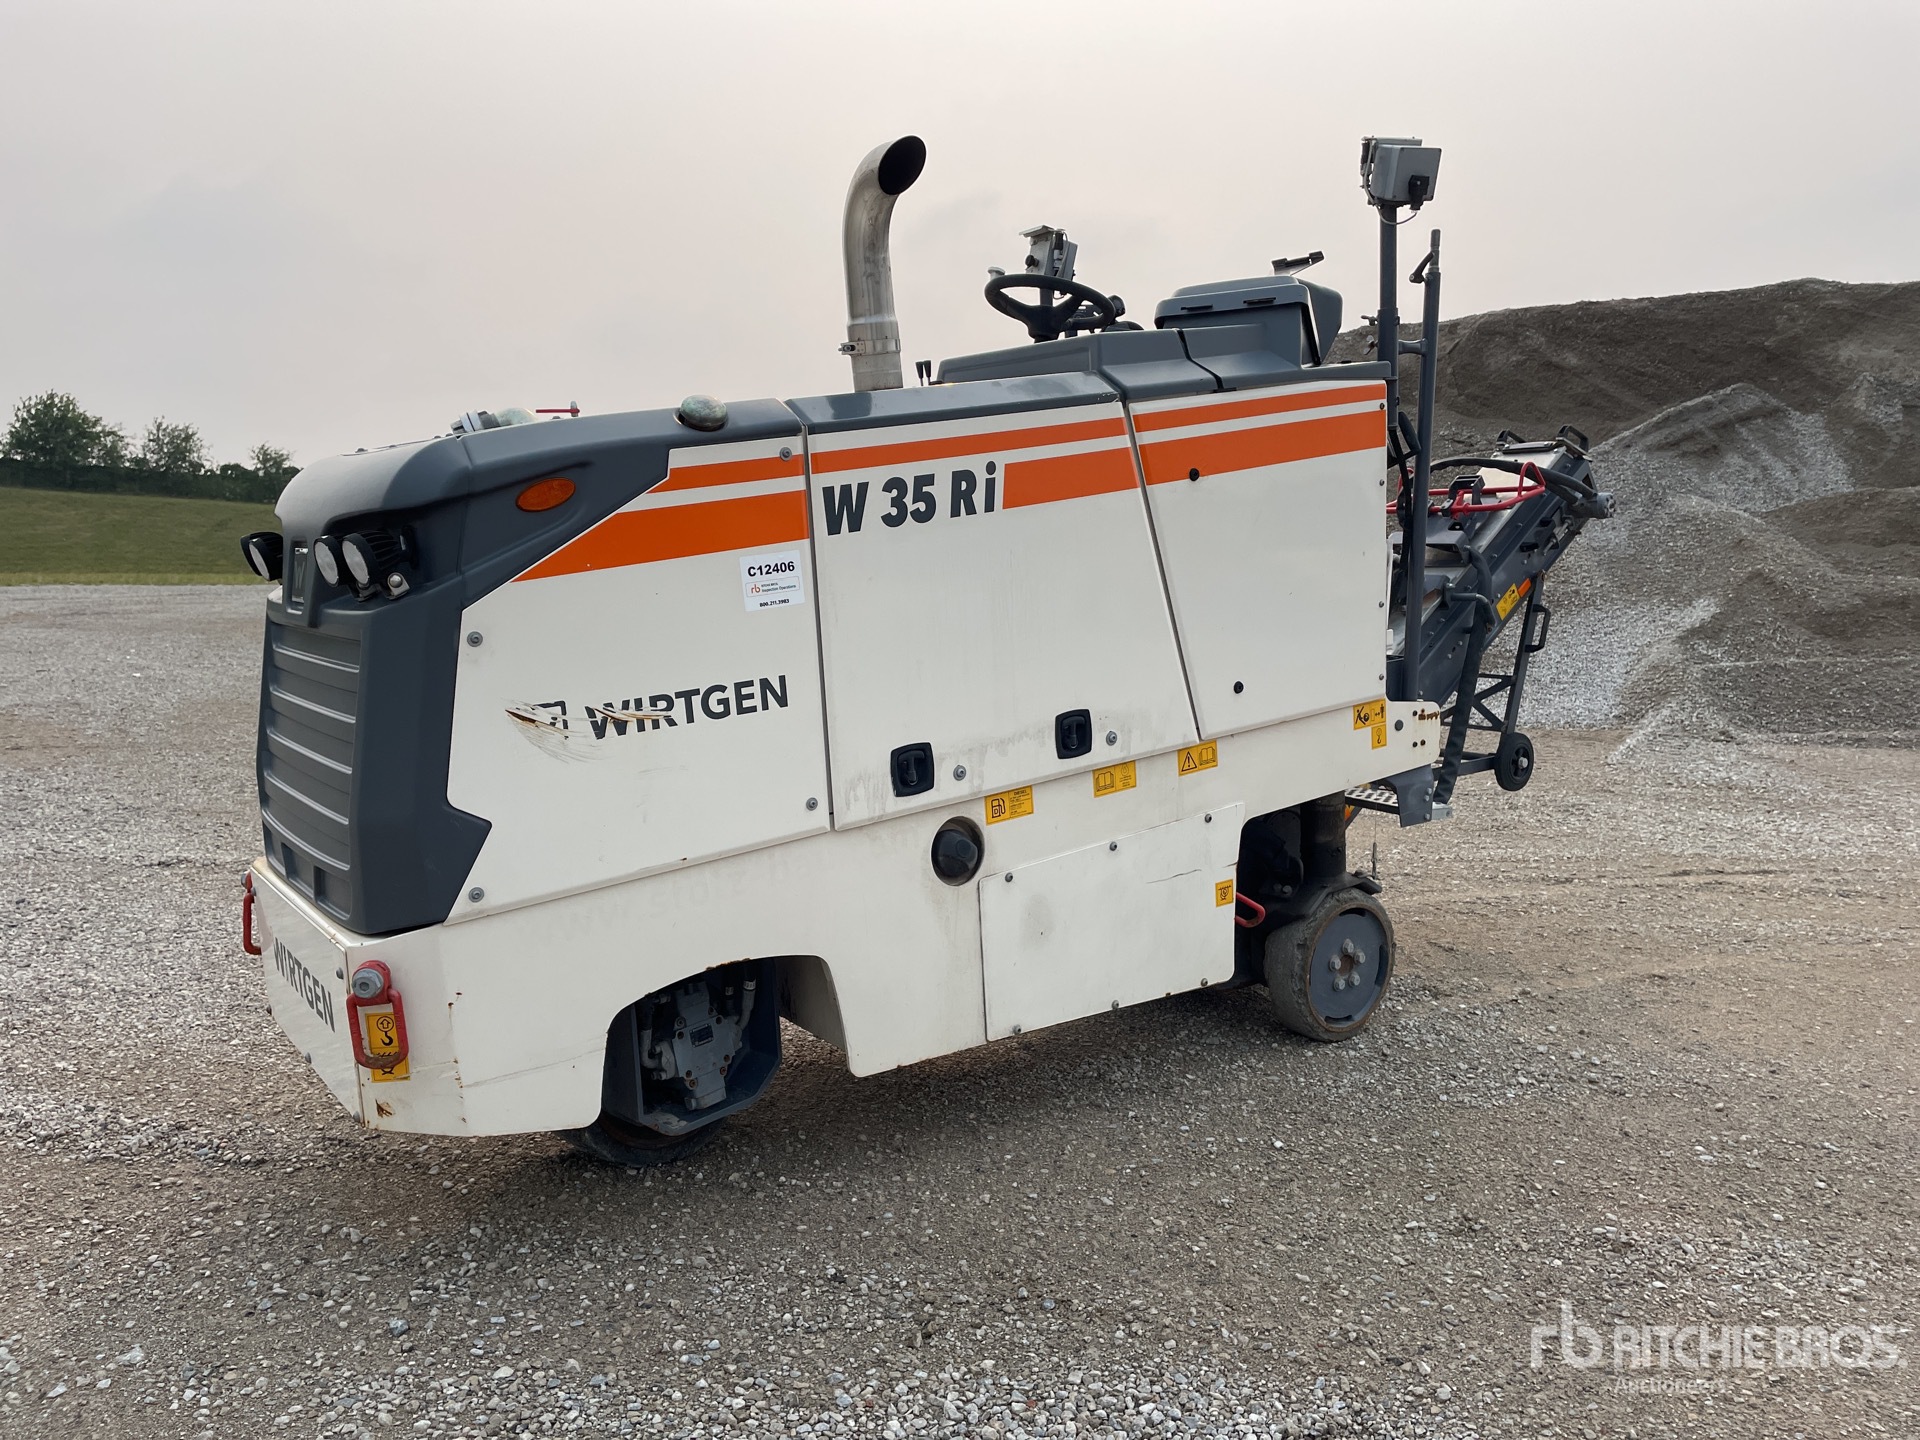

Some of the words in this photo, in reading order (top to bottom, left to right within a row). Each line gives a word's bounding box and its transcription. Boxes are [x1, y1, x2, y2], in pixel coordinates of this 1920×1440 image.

[822, 481, 870, 536] W
[880, 473, 937, 528] 35
[950, 460, 997, 518] Ri
[747, 561, 795, 577] C12406
[584, 674, 789, 740] WIRTGEN
[273, 936, 336, 1033] WIRTGEN
